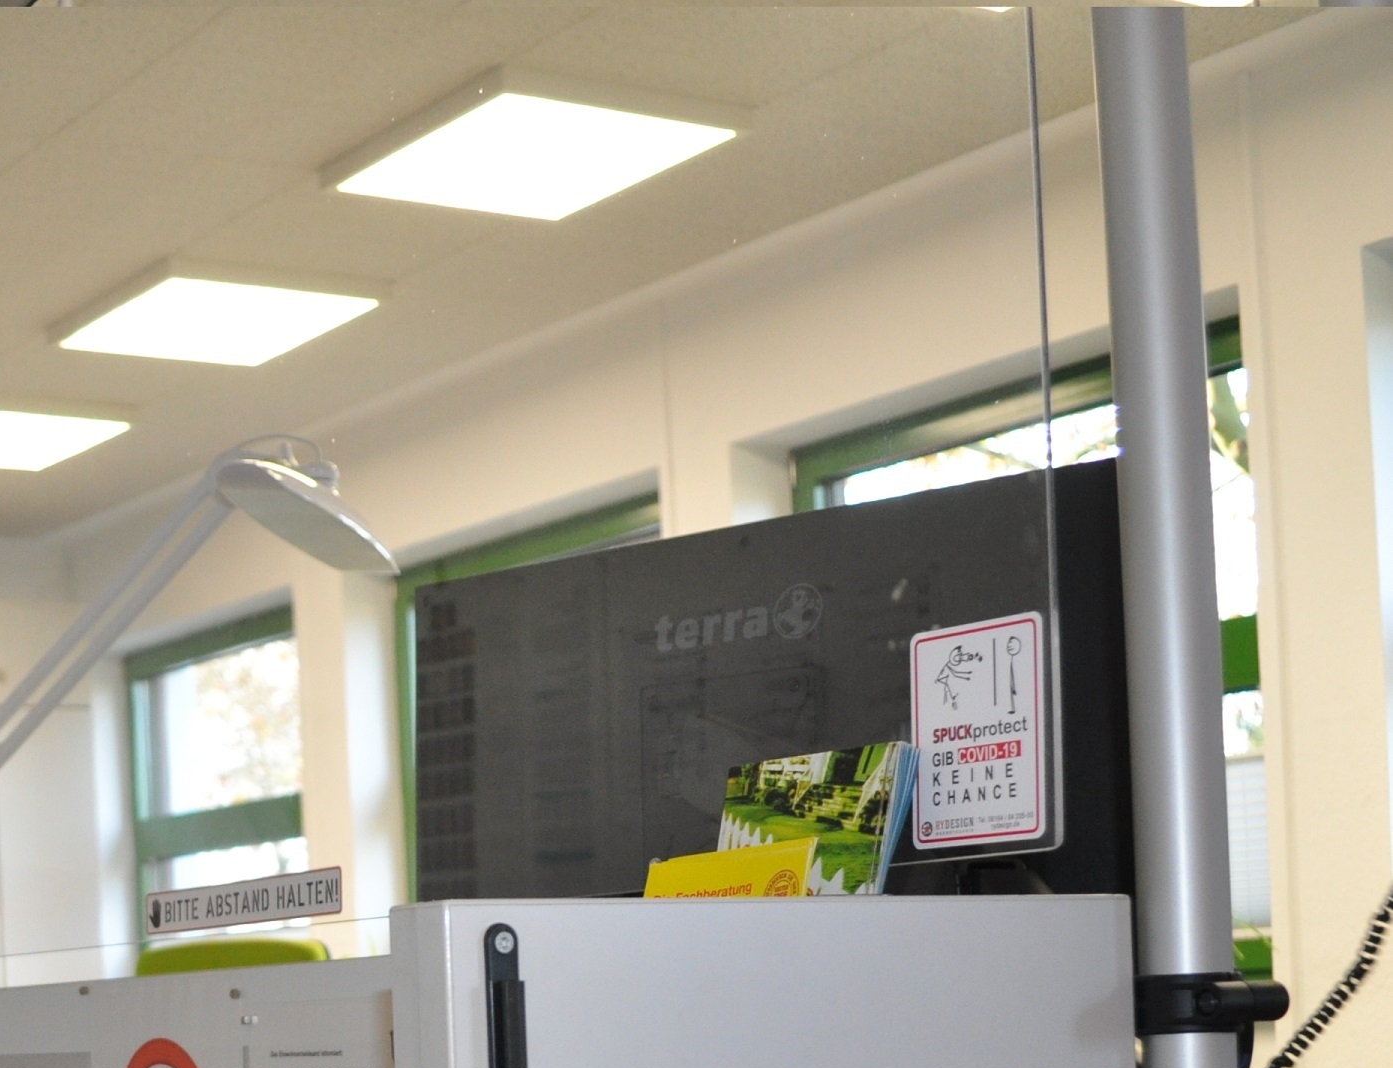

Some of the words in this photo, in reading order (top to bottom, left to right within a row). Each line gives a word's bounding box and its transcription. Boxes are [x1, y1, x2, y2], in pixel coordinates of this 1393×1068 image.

[654, 606, 769, 653] terra
[932, 716, 1028, 744] SPUCKprotect
[932, 751, 954, 767] GIB
[957, 741, 1019, 764] COVID-19
[932, 782, 1018, 807] CHANCE
[935, 816, 974, 831] RYDESIGN
[164, 897, 199, 923] BITTE
[205, 888, 270, 918] ABSTAND
[276, 877, 339, 910] HALTEN!
